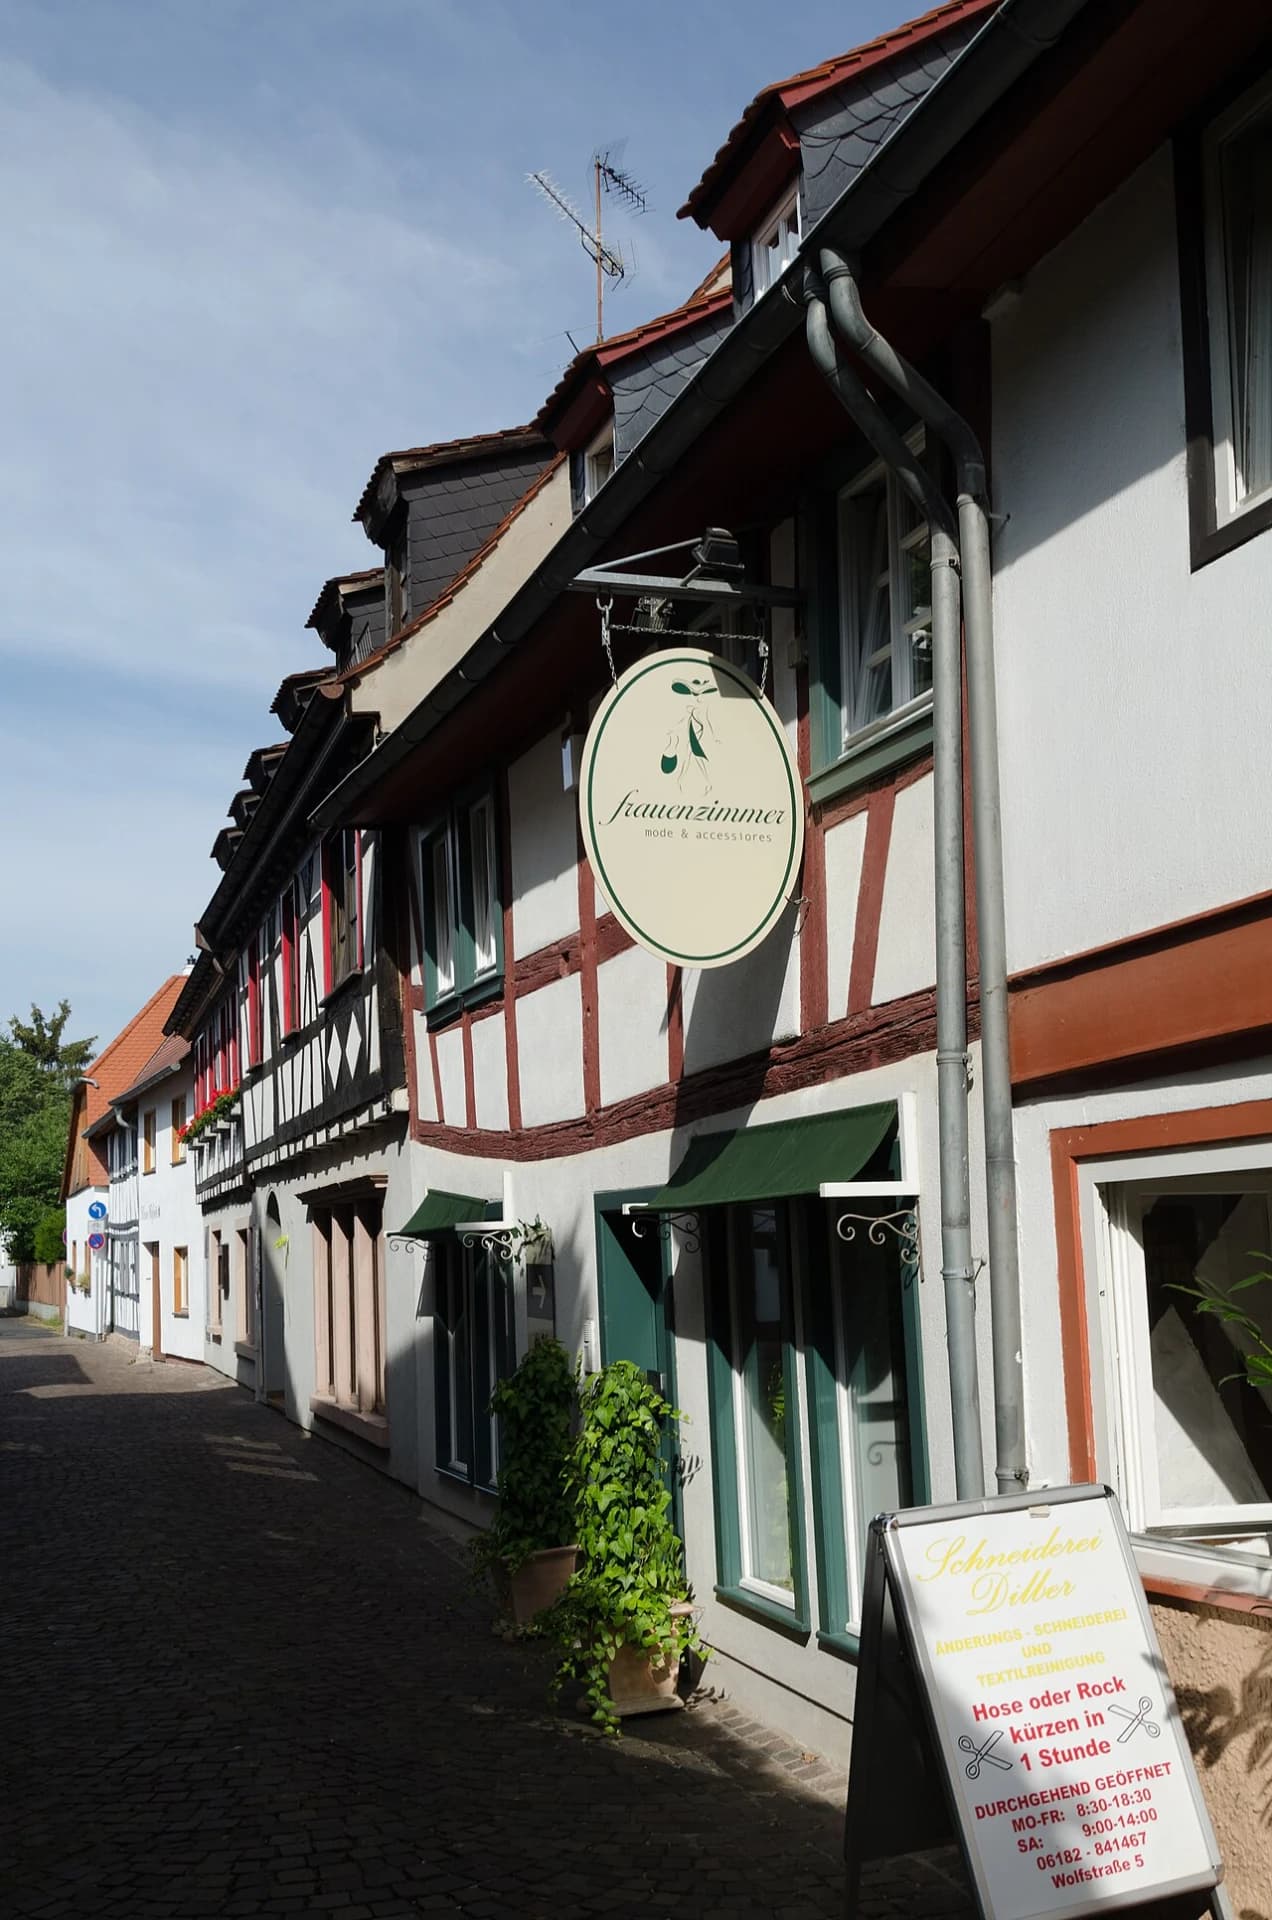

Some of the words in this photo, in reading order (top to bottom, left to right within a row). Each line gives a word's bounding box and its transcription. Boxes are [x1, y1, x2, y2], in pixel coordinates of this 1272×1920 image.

[599, 789, 785, 825] frauenzimmer
[645, 828, 673, 838] mode
[681, 830, 689, 839] &
[916, 1526, 1103, 1582] Schneiderei
[966, 1568, 1076, 1616] Dilber
[1033, 1608, 1128, 1637] SCHNEIDEREI
[1021, 1642, 1052, 1658] UND
[977, 1651, 1105, 1687] TEXTILREINIGUNG
[972, 1700, 1023, 1722] Hose
[1029, 1690, 1071, 1710] oder
[1076, 1676, 1127, 1700] Rock
[1009, 1716, 1080, 1744] kürzen
[1083, 1710, 1105, 1728] in
[1019, 1753, 1032, 1771] 1
[1039, 1738, 1111, 1768] Stunde
[974, 1782, 1090, 1819] DURCHGEHEND
[1094, 1762, 1171, 1791] GEÖFFNET
[1012, 1810, 1065, 1833] MO-FR:
[1076, 1788, 1151, 1817] 8:30-18:30
[1017, 1837, 1044, 1853] SA:
[1082, 1807, 1158, 1837] 9:00-14:00
[1036, 1848, 1082, 1871] 06182
[1094, 1832, 1147, 1856] 841467
[1051, 1859, 1131, 1889] Wolfstraße
[1134, 1854, 1145, 1868] 5
